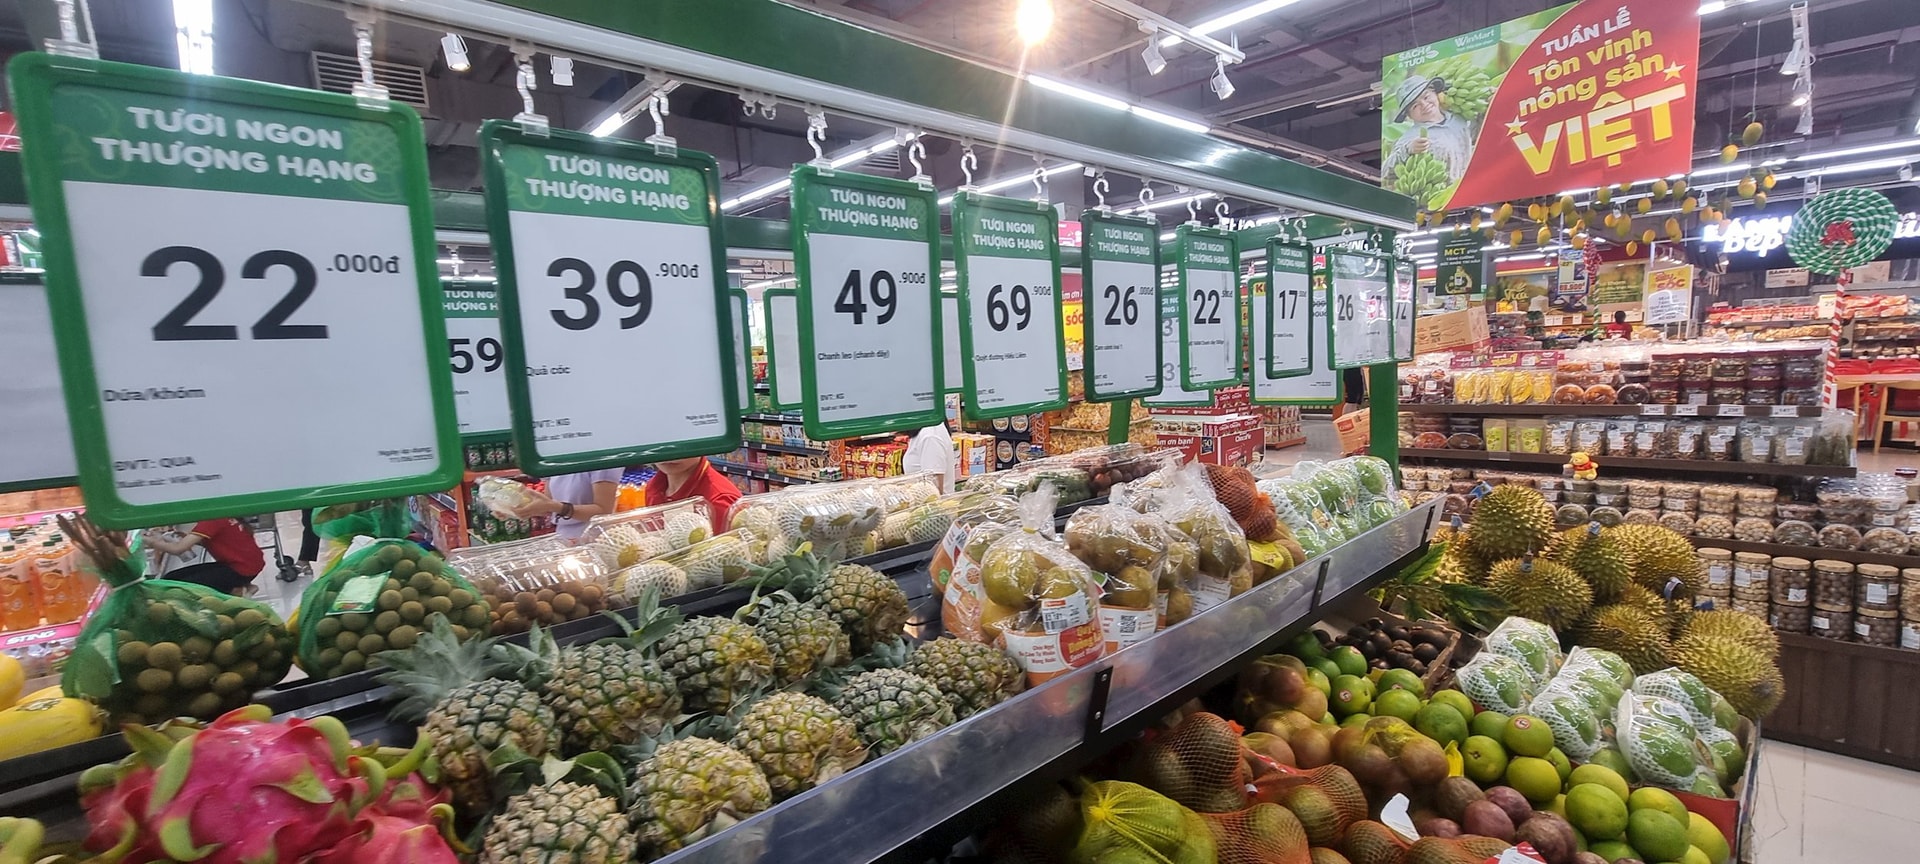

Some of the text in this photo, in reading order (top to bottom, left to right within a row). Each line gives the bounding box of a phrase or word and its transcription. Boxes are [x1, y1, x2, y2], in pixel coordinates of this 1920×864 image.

[1542, 7, 1631, 56] TUẦN LỄ
[1528, 28, 1653, 86] Tôn vinh
[1519, 53, 1664, 117] nông sản
[126, 106, 343, 150] TƯƠI NGON
[1511, 83, 1686, 175] VIỆT
[91, 137, 378, 184] THƯỢNG HẠNG
[545, 155, 670, 185] TƯƠI NGON
[525, 178, 690, 211] THƯỢNG HẠNG
[830, 189, 906, 210] TƯƠI NGON
[818, 207, 918, 231] THƯỢNG HẠNG
[981, 218, 1035, 234] TƯƠI NGON
[1104, 228, 1144, 242] TƯƠI NGON
[972, 234, 1044, 252] THƯỢNG HẠNG
[1098, 241, 1150, 257] THƯỢNG HẠNG
[1444, 248, 1466, 256] MCT
[140, 246, 400, 341] 22 .000đ
[546, 257, 700, 331] 39 .900đ
[834, 269, 925, 326] 49 .900đ
[986, 284, 1031, 332] 69
[1104, 285, 1138, 326] 26
[1193, 289, 1221, 325] 22
[1279, 290, 1298, 319] 17
[1337, 294, 1353, 321] 26
[448, 337, 504, 374] 59
[6, 630, 56, 644] STING
